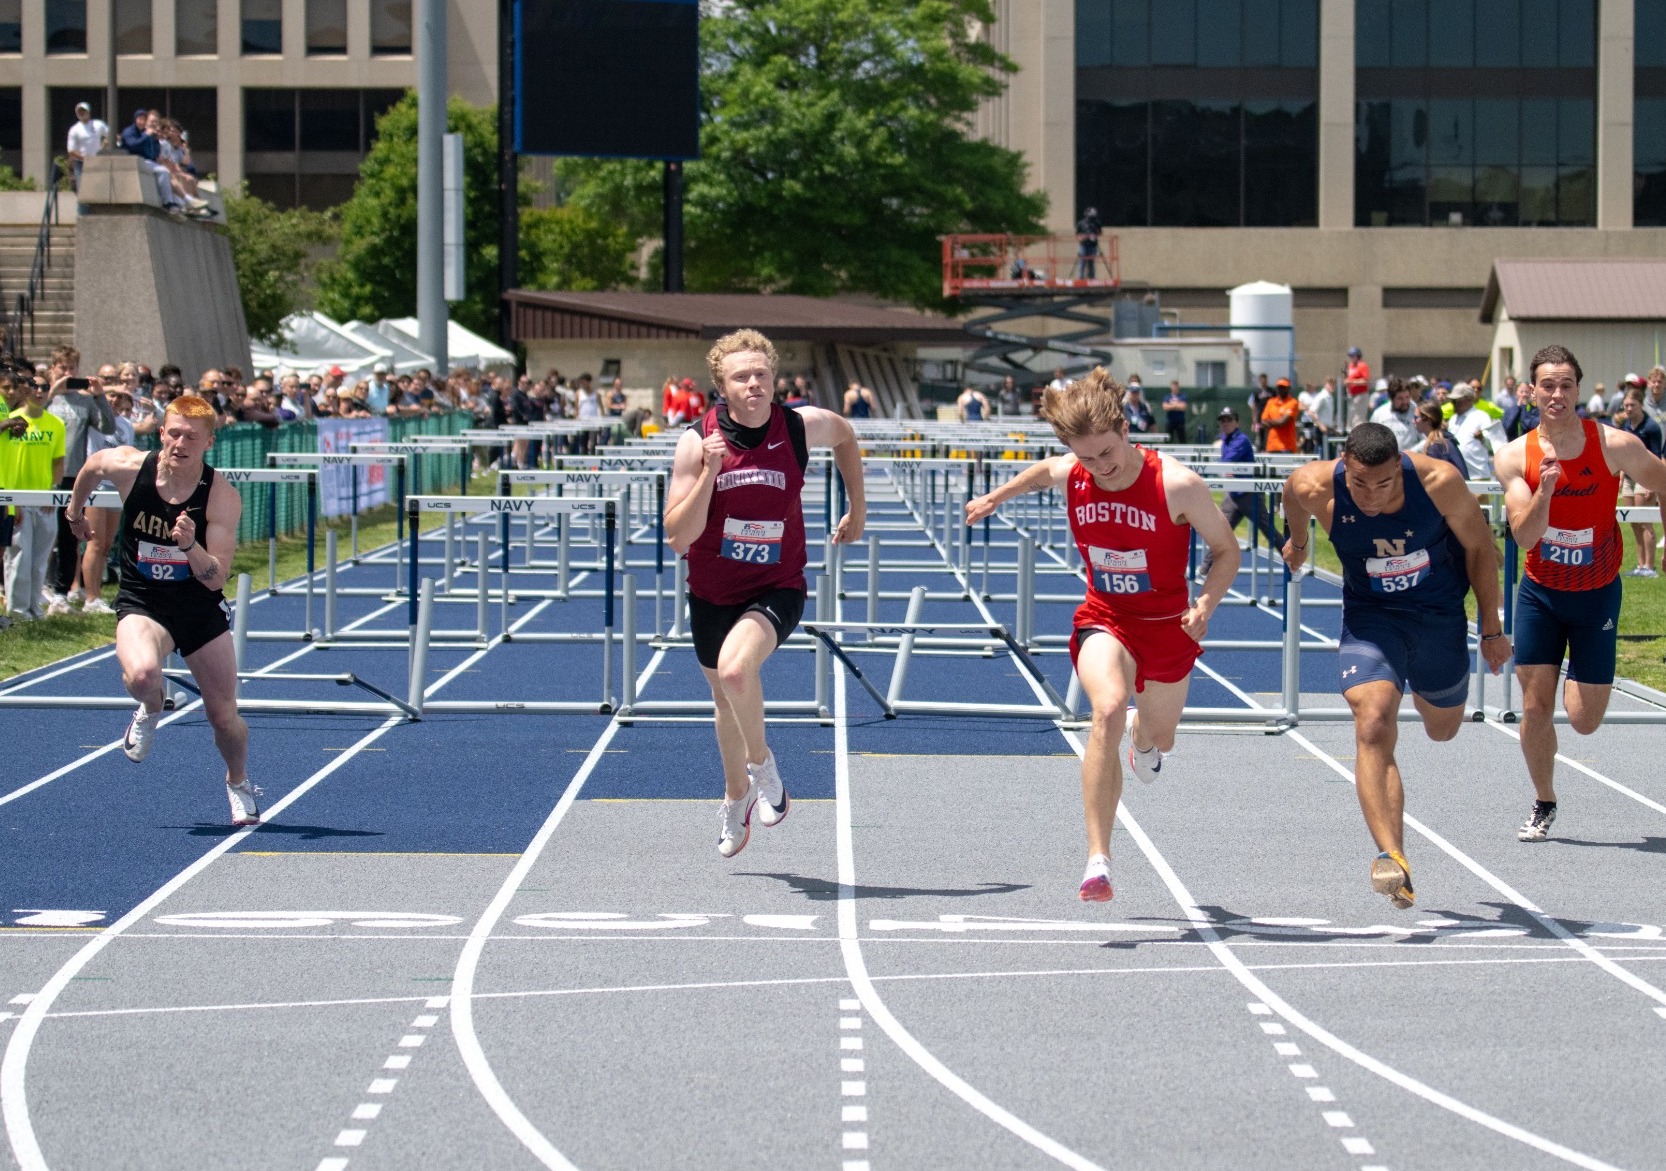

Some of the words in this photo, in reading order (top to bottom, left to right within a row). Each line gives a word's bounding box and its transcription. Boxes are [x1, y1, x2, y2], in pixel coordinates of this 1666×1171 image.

[323, 456, 352, 464] NAVY
[600, 459, 647, 467] NAVY
[893, 461, 922, 469] NAVY
[566, 474, 602, 483] NAVY
[1552, 483, 1600, 497] cknell
[53, 494, 97, 506] NAY
[490, 499, 535, 511] NAVY
[1075, 502, 1157, 532] BOSTON
[133, 510, 177, 542] ARM
[731, 542, 770, 563] 373
[1372, 538, 1406, 557] N
[1550, 545, 1583, 565] 210
[151, 563, 175, 580] 92
[1101, 573, 1140, 594] 156
[1381, 571, 1420, 593] 537
[867, 627, 936, 635] NAVY
